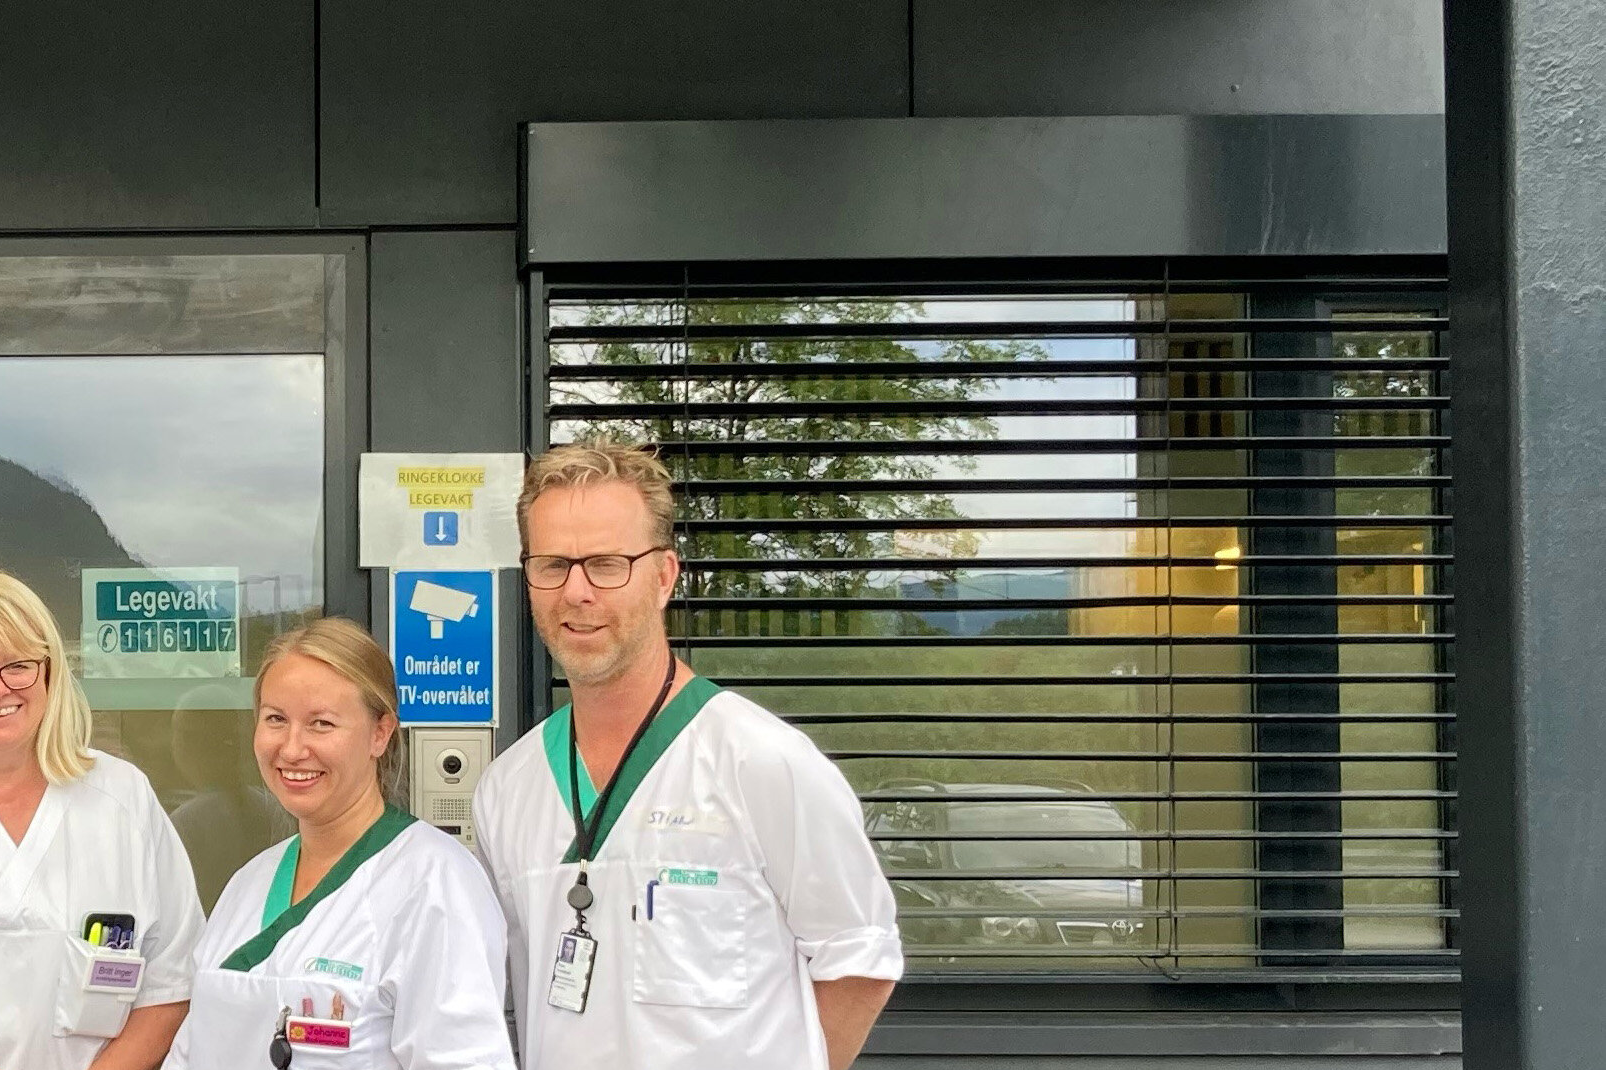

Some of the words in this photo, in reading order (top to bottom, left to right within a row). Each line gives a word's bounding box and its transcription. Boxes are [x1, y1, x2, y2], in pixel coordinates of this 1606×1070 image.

[397, 471, 485, 484] RINGEKLOKKE
[409, 493, 473, 505] LEGEVAKT
[116, 585, 218, 618] Legevakt
[124, 626, 233, 649] 116117
[404, 654, 462, 675] Området
[465, 660, 480, 675] er
[398, 684, 490, 706] TV-overvåket
